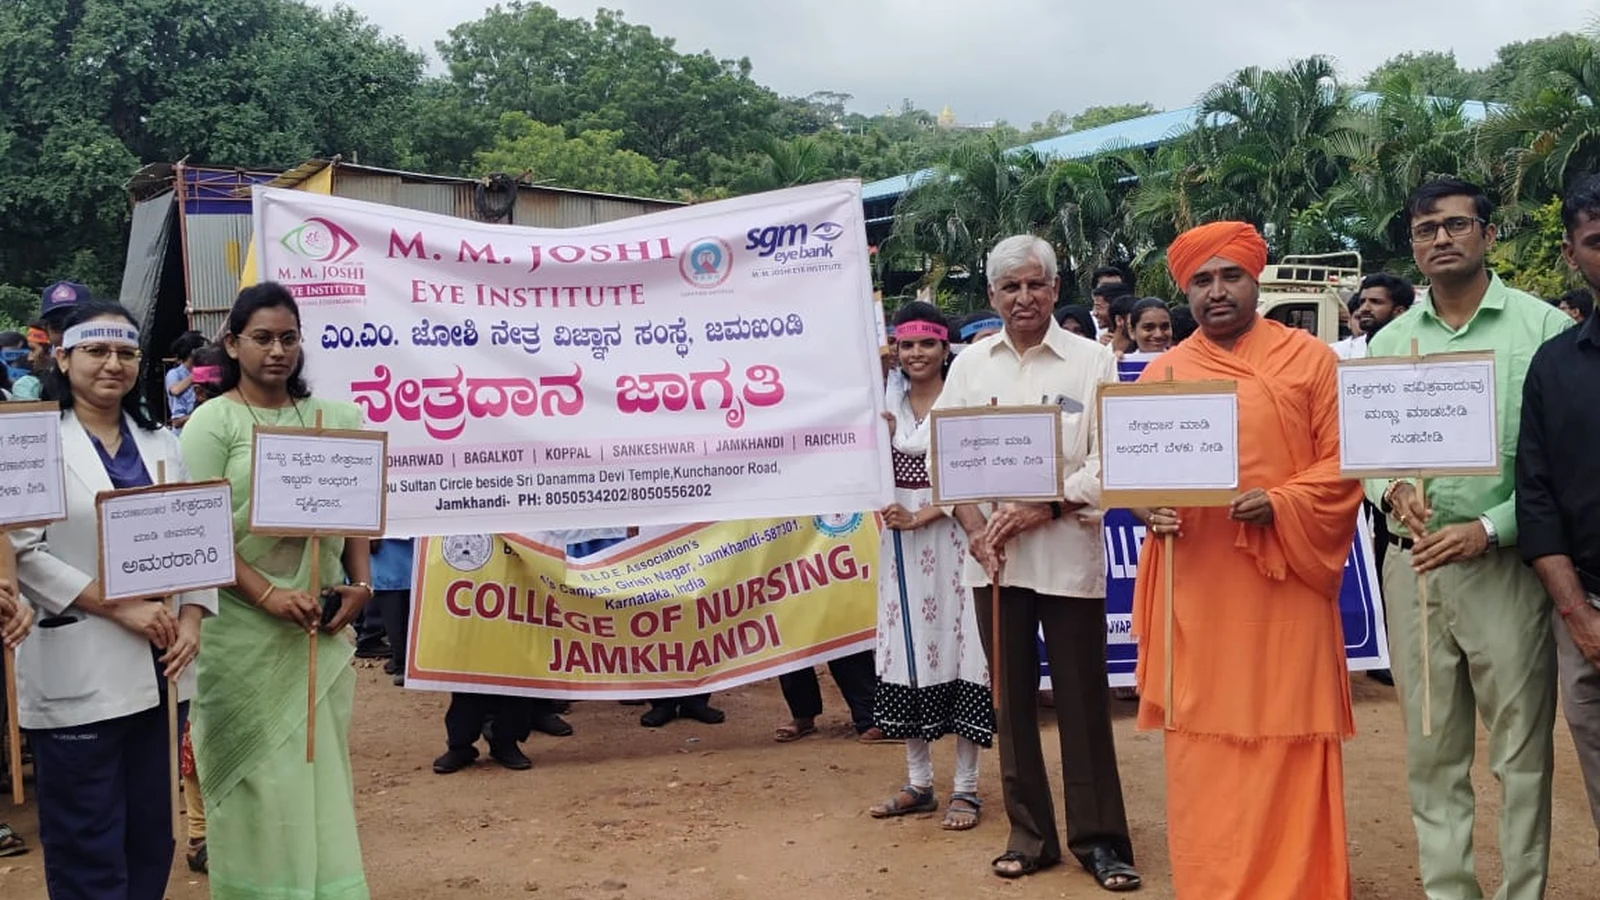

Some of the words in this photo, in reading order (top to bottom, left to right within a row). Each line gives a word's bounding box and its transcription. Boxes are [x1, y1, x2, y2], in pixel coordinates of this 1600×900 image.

[388, 229, 441, 260] M.
[456, 240, 511, 264] M.
[528, 237, 675, 273] JOSHI
[746, 222, 807, 257] sgm
[278, 266, 296, 279] M.
[301, 266, 318, 279] M.
[322, 266, 364, 280] JOSHI
[288, 286, 304, 297] YE
[307, 285, 361, 296] INSTITUTE
[411, 280, 464, 303] EYE
[476, 283, 645, 308] INSTITUTE
[321, 323, 399, 349] ಎಂ.ಎಂ.
[411, 319, 479, 346] ಜೋಶಿ
[491, 320, 541, 354] ನೇತ್ರ
[553, 322, 621, 360] ವಿಜ್ಞಾನ
[705, 312, 804, 343] ಜಮಖಂಡಿ
[351, 362, 584, 440] ನೇತ್ರದಾನ
[616, 357, 785, 429] ಜಾಗೃತಿ
[1346, 382, 1397, 399] ನೇತ್ರಗಳು
[1128, 420, 1174, 435] ನೇತ್ರದಾನ
[1180, 418, 1210, 430] ಮಾಡಿ
[1364, 408, 1400, 426] ಮಣ್ಣು
[1406, 404, 1467, 419] ಮಾಡಬೇಡಿ
[464, 449, 524, 464] BAGALKOT
[545, 447, 591, 461] KOPPAL
[612, 441, 695, 457] SANKESHWAR
[716, 436, 784, 452] JAMKHANDI
[804, 432, 856, 447] RAICHUR
[1116, 442, 1158, 456] ಅಂಧರಿಗೆ
[1164, 442, 1193, 454] ಬೆಳಕು
[1199, 442, 1223, 453] ನೀಡಿ
[1390, 430, 1443, 445] ಸುಡಬೇಡಿ
[400, 479, 437, 493] Sultan
[440, 476, 473, 491] Circle
[475, 473, 513, 490] beside
[516, 472, 533, 487] Sri
[537, 469, 596, 486] Danamma
[599, 468, 625, 484] Devi
[748, 461, 781, 475] Road,
[171, 496, 223, 516] ನೇತ್ರದಾನ
[435, 493, 511, 511] Jamkhandi-
[518, 493, 541, 507] PH:
[545, 484, 712, 506] 8050534202/8050556202
[122, 546, 218, 574] ಅಮರರಾಗಿರಿ
[626, 538, 700, 576] Association's
[616, 575, 652, 590] Girish
[655, 561, 696, 583] Nagar,
[446, 581, 616, 637] COLLEGE
[630, 606, 683, 638] OF
[698, 544, 869, 629] NURSING,
[604, 587, 675, 610] Karnataka,
[677, 577, 707, 596] India
[548, 614, 782, 674] JAMKHANDI
